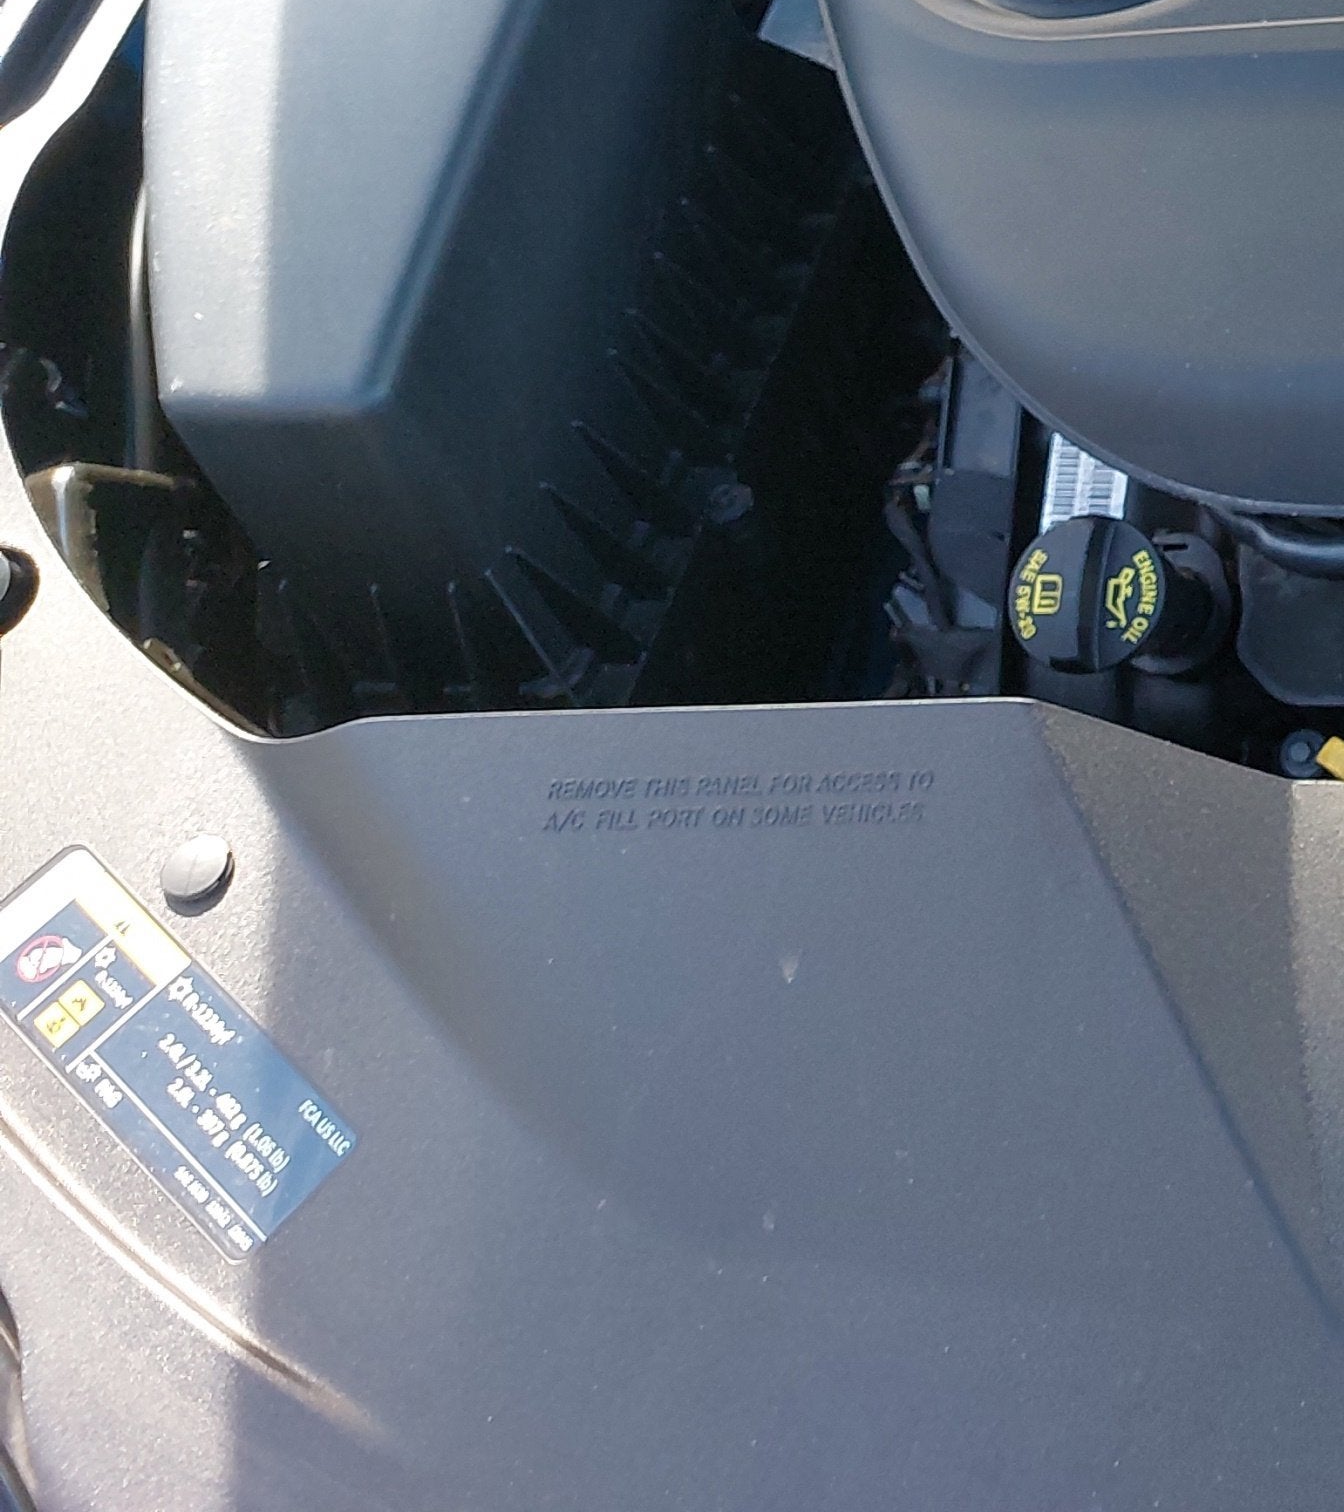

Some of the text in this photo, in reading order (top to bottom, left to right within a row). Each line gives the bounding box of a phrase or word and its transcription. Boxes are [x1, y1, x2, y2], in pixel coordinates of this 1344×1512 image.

[1020, 548, 1048, 582] SAE
[1121, 549, 1160, 644] ENGINE OIL
[547, 769, 937, 800] REMOVE THIS PANEL FOR ACCESS TO
[541, 800, 925, 832] A/C FILL PORT ON SOME VEHICLES
[298, 1100, 351, 1157] FCA US LLC
